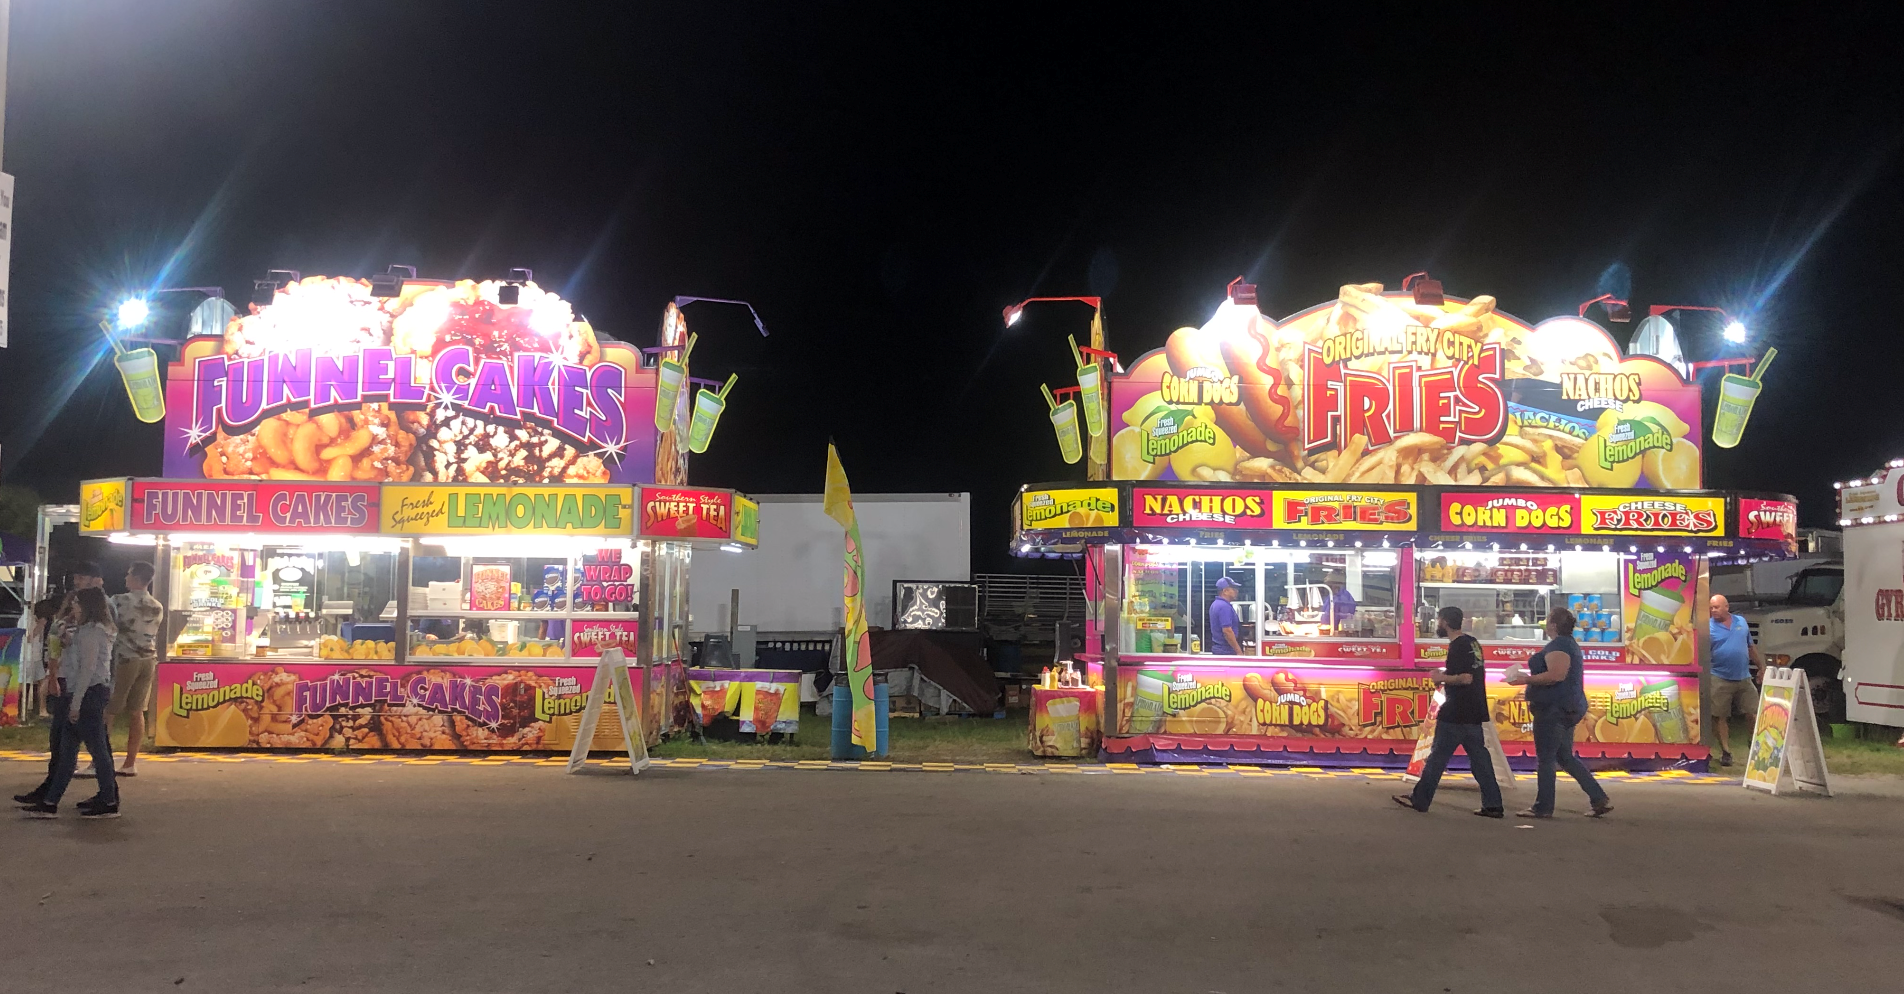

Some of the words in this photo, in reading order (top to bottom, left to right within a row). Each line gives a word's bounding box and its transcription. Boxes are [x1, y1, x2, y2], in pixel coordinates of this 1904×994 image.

[1322, 328, 1403, 367] ORIGINAL
[1406, 325, 1440, 355] FRY
[1443, 330, 1483, 369] CITY
[1161, 371, 1198, 405] CORN
[1203, 374, 1241, 405] DOGS
[1561, 372, 1642, 402] NACHOS
[192, 345, 429, 437] FUNNEL
[431, 345, 627, 447] CAKES
[1303, 342, 1508, 452] FRIES
[1577, 398, 1623, 413] CHEESE
[1152, 424, 1178, 436] Squeezed
[1157, 417, 1173, 427] Fresh
[1614, 422, 1631, 433] Fresh
[1140, 422, 1216, 464] Lemonade
[1598, 429, 1673, 471] Lemonade
[400, 490, 434, 513] Fresh
[655, 492, 697, 502] Southern
[700, 494, 722, 505] Style
[1033, 494, 1050, 502] Fresh
[1143, 494, 1265, 516] NACHOS
[1304, 495, 1343, 505] ORIGINAL
[1346, 494, 1363, 503] FRY
[1365, 496, 1385, 505] CITY
[1486, 497, 1538, 510] JUMBO
[144, 489, 262, 525] FUNNEL
[269, 492, 368, 527] CAKES
[447, 493, 621, 531] LEMONADE
[1023, 497, 1115, 527] Lemonade
[1283, 498, 1412, 526] FRIES
[1618, 501, 1688, 513] CHEESE
[391, 504, 446, 531] Squeezed
[646, 501, 697, 530] SWEET
[700, 504, 728, 534] TEA
[1166, 512, 1236, 525] CHEESE
[1449, 503, 1508, 529] CORN
[1515, 504, 1573, 529] DOGS
[1592, 508, 1718, 533] FRIES
[1747, 510, 1794, 535] SWEET
[1062, 530, 1109, 538] LEMONADE
[1293, 533, 1344, 541] LEMONADE
[1565, 538, 1614, 546] LEMONADE
[598, 549, 622, 563] WE
[585, 565, 633, 582] WRAP
[1628, 559, 1686, 598] Lemonade
[582, 585, 600, 602] TO
[604, 584, 633, 602] GO!
[475, 599, 505, 610] CAKES
[584, 624, 609, 634] Southern
[573, 631, 613, 655] SWEET
[614, 632, 636, 655] TEA
[1265, 646, 1312, 655] Lemonade
[186, 678, 219, 690] Squeezed
[193, 671, 214, 682] Fresh
[555, 676, 577, 687] Fresh
[1177, 673, 1193, 683] Fresh
[1369, 677, 1420, 692] ORIGINAL
[549, 684, 581, 696] Squeezed
[1172, 680, 1199, 692] Squeezed
[173, 680, 265, 717] Lemonade
[292, 675, 407, 721] FUNNEL
[408, 676, 502, 724] CAKES
[1162, 681, 1231, 714] Lemonade
[1276, 694, 1308, 706] JUMBO
[1358, 682, 1432, 727] FRI
[1256, 701, 1291, 726] CORN
[1293, 700, 1328, 726] DOGS
